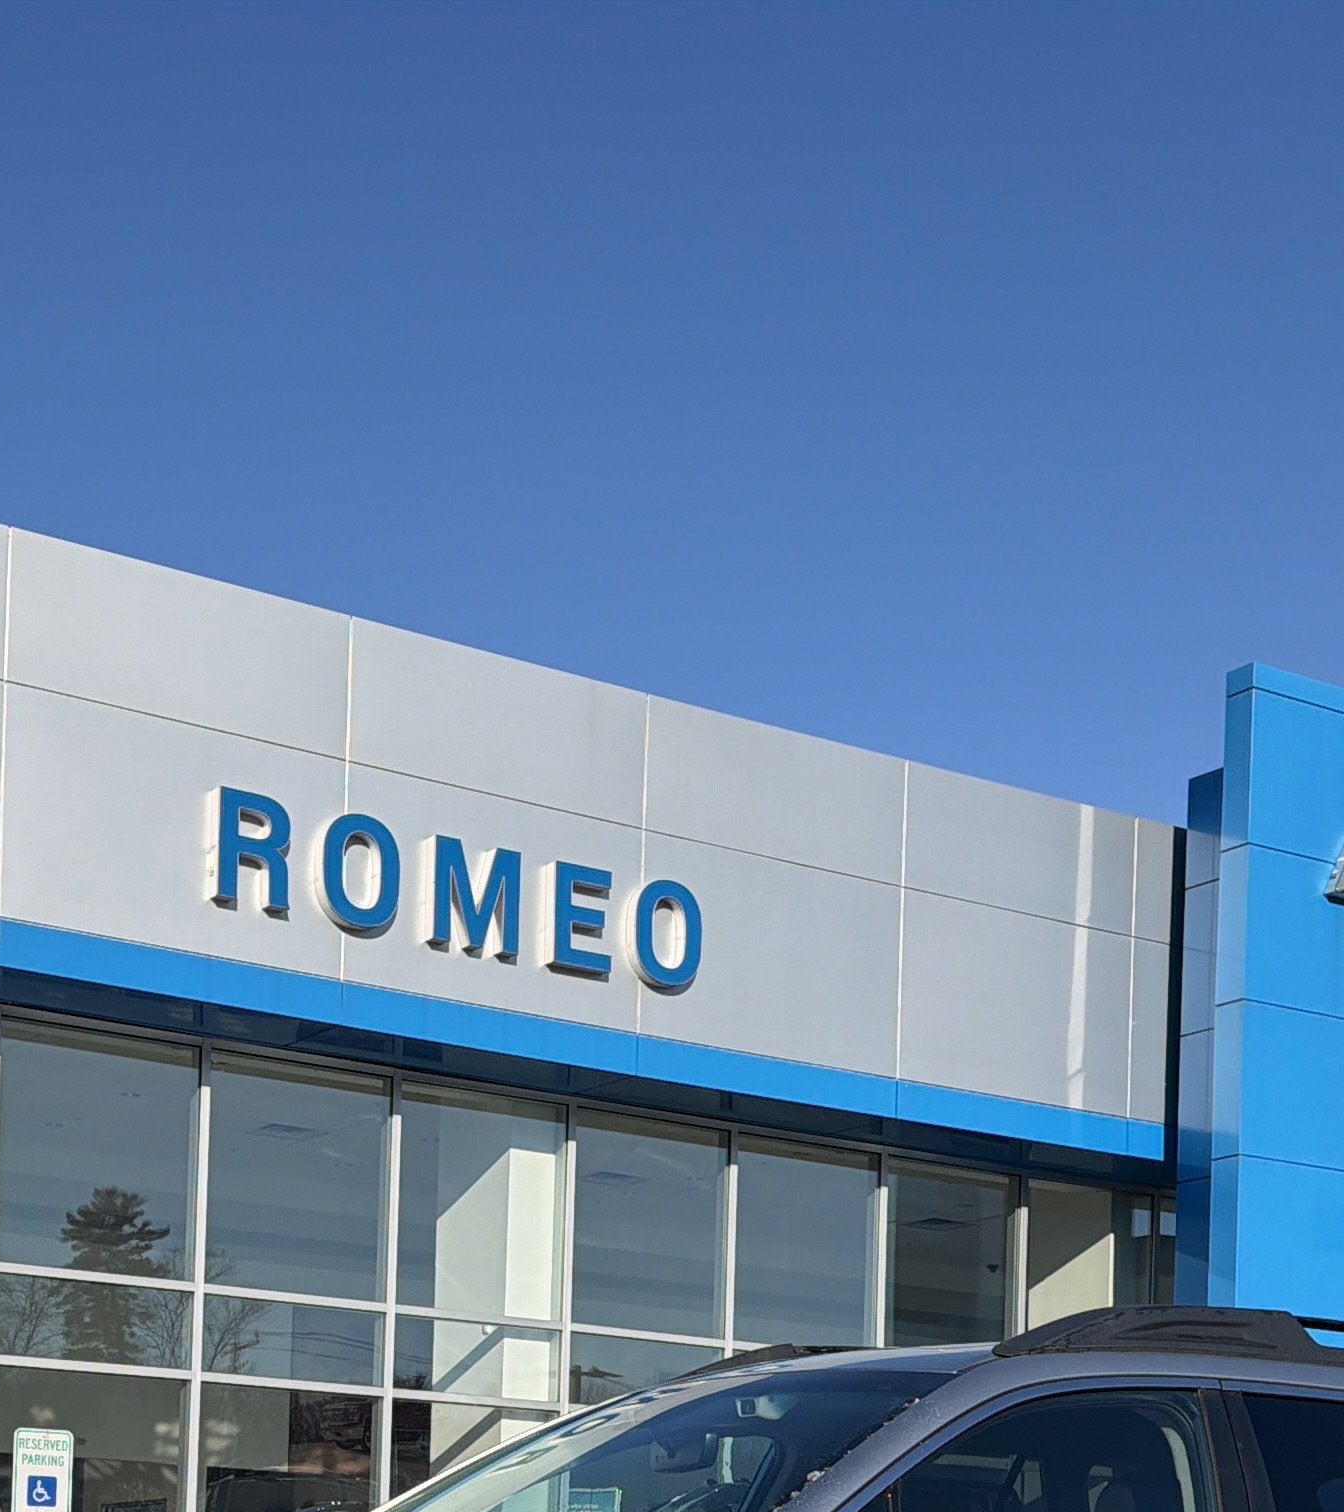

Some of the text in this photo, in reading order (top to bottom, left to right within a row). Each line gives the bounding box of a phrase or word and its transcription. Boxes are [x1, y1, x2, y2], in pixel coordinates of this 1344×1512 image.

[209, 786, 703, 989] ROMEO
[18, 1437, 69, 1452] RESERVED
[21, 1453, 65, 1467] PARKING
